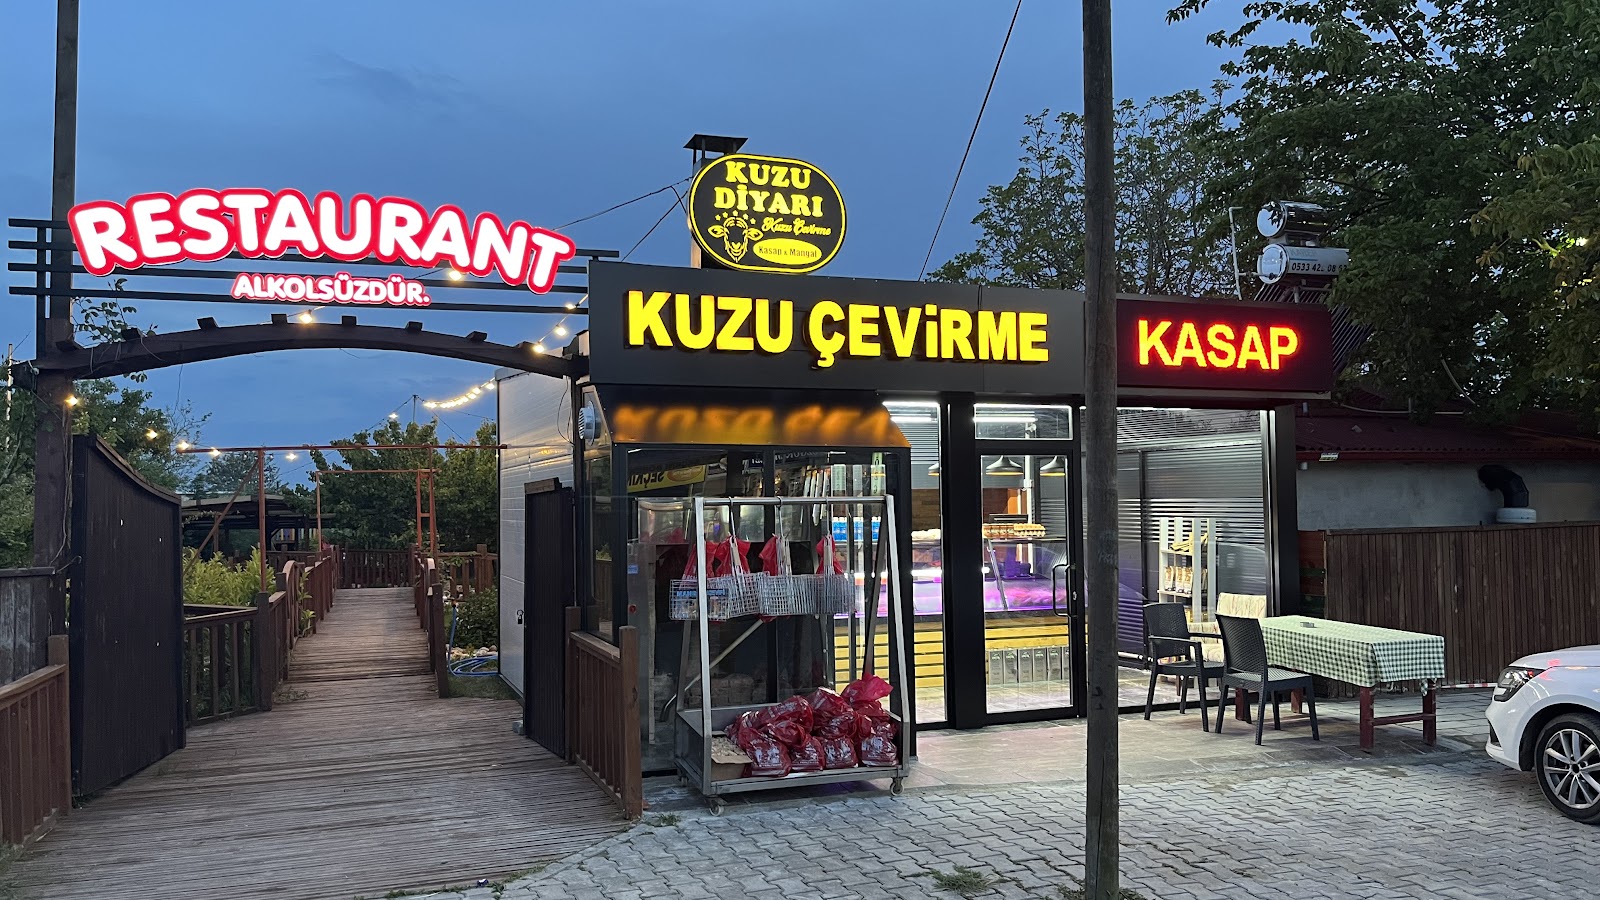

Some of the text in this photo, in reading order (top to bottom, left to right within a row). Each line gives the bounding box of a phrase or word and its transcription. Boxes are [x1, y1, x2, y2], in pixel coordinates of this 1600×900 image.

[725, 160, 812, 190] KUZU
[713, 184, 823, 218] DİYARI
[70, 188, 576, 294] RESTAURANT
[761, 216, 793, 233] Kuzu
[758, 245, 782, 256] Kasap
[789, 248, 817, 258] Mangal
[1291, 262, 1310, 272] 0533
[1327, 264, 1337, 273] 08
[232, 272, 431, 305] ALKOLSÜZDÜR.
[627, 289, 794, 353] KUZU
[1137, 318, 1299, 370] KASAP
